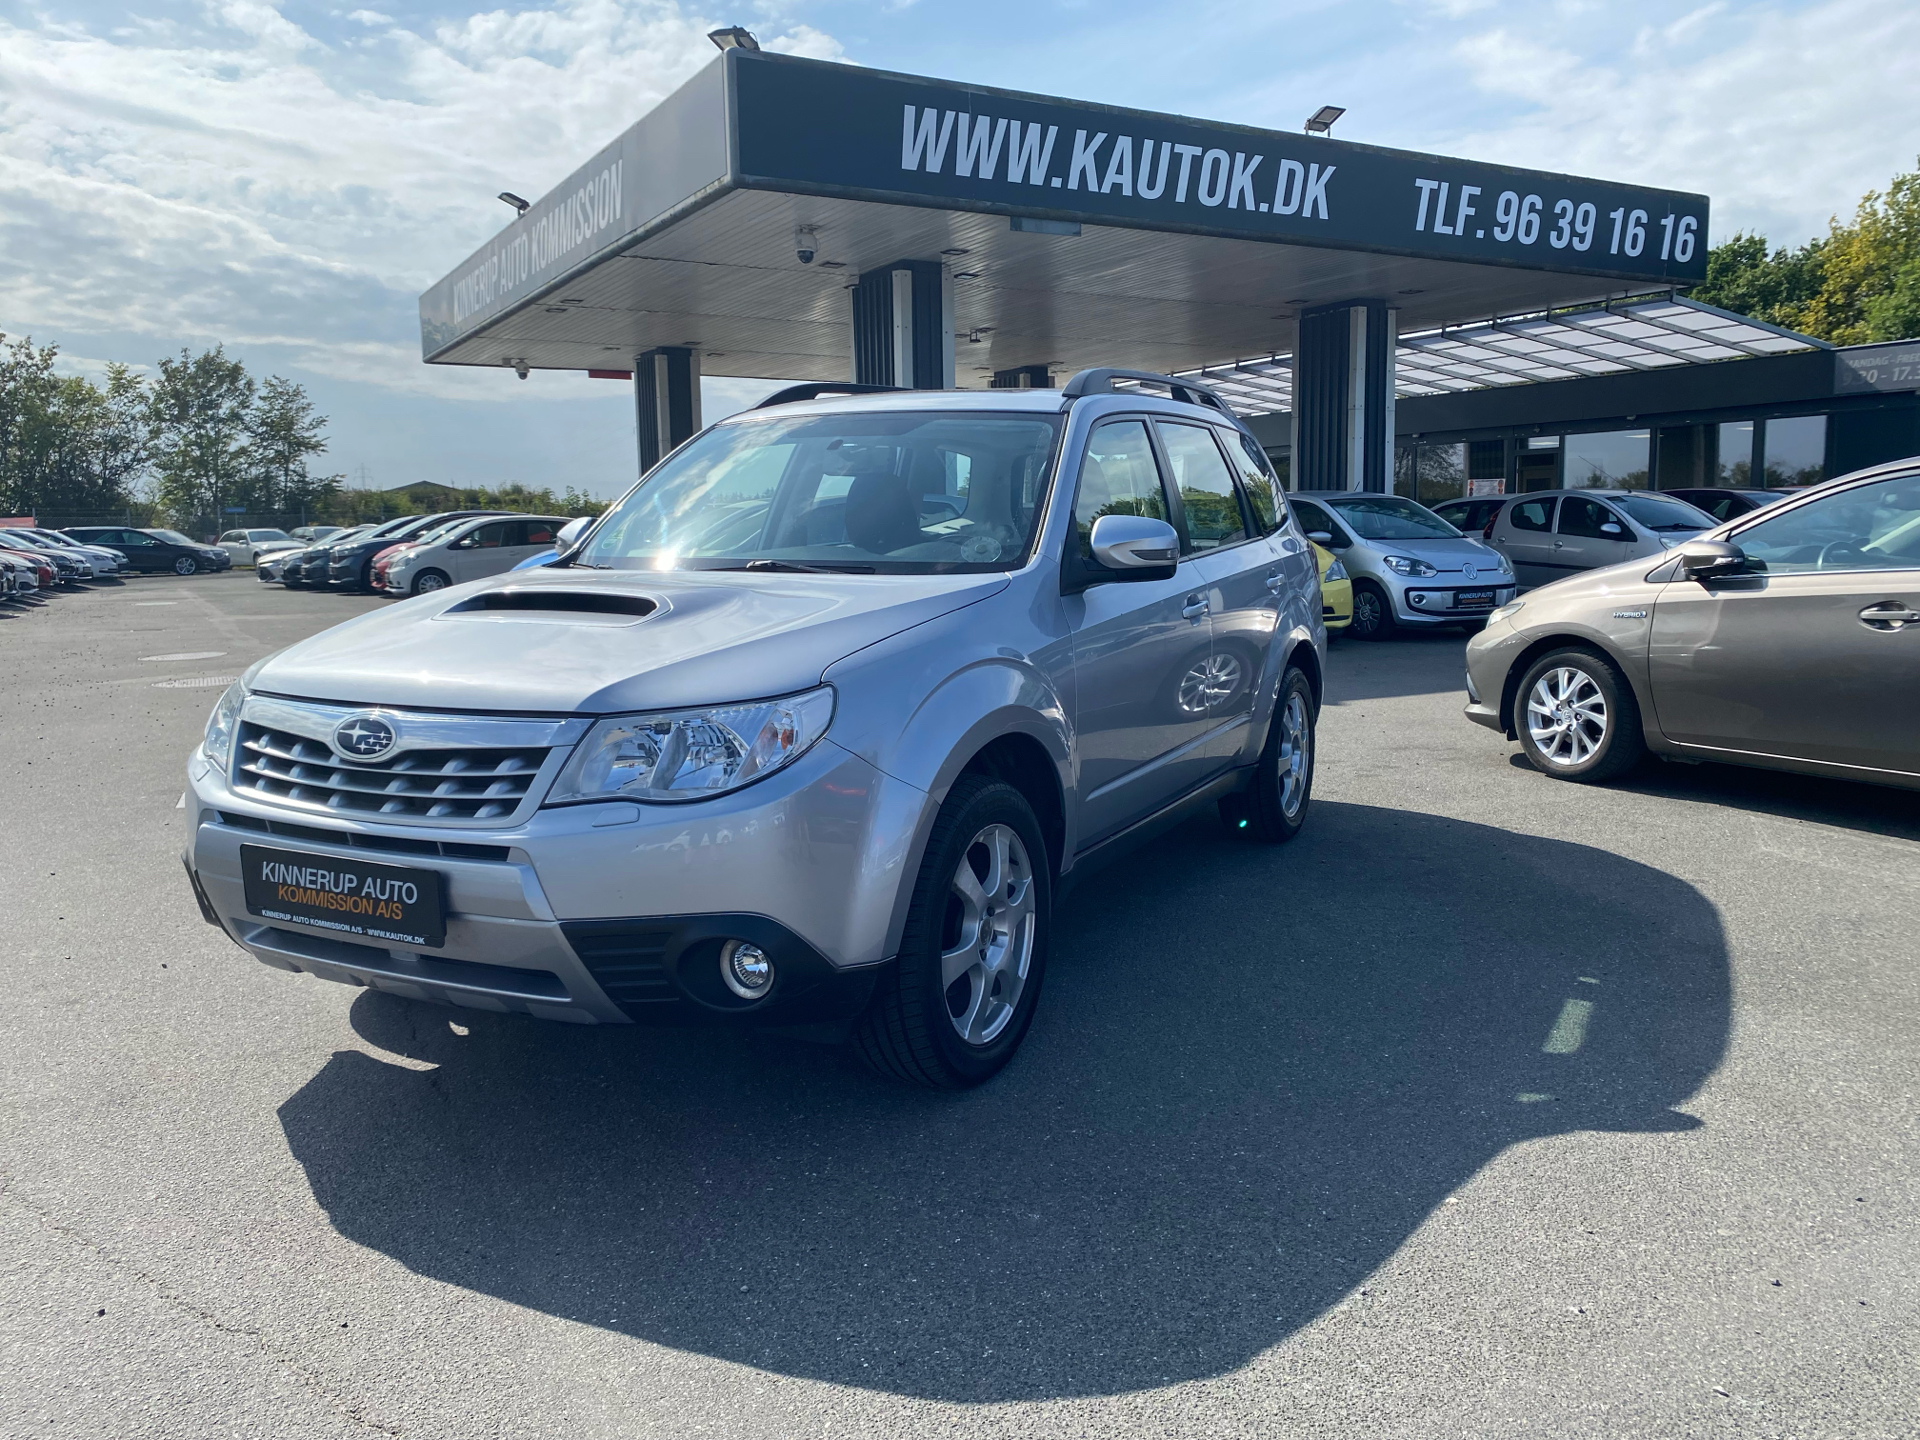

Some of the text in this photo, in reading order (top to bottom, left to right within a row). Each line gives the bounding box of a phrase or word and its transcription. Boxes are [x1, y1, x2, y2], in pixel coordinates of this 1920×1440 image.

[901, 104, 1337, 220] WWW.KAUTOK.DK
[453, 159, 623, 325] KINNERUP AUTO KOMMISSION
[1415, 178, 1698, 263] TLF. 96 39 16 16
[262, 861, 418, 904] KINNERUP AUTO
[278, 884, 403, 920] KOMMISSION A/S
[261, 909, 292, 921] KINNERUP
[292, 915, 309, 925] AUTO
[310, 918, 350, 932] KOMMISSION
[351, 926, 363, 934] A/S
[367, 928, 426, 945] WWW.KAUTOK.DK
